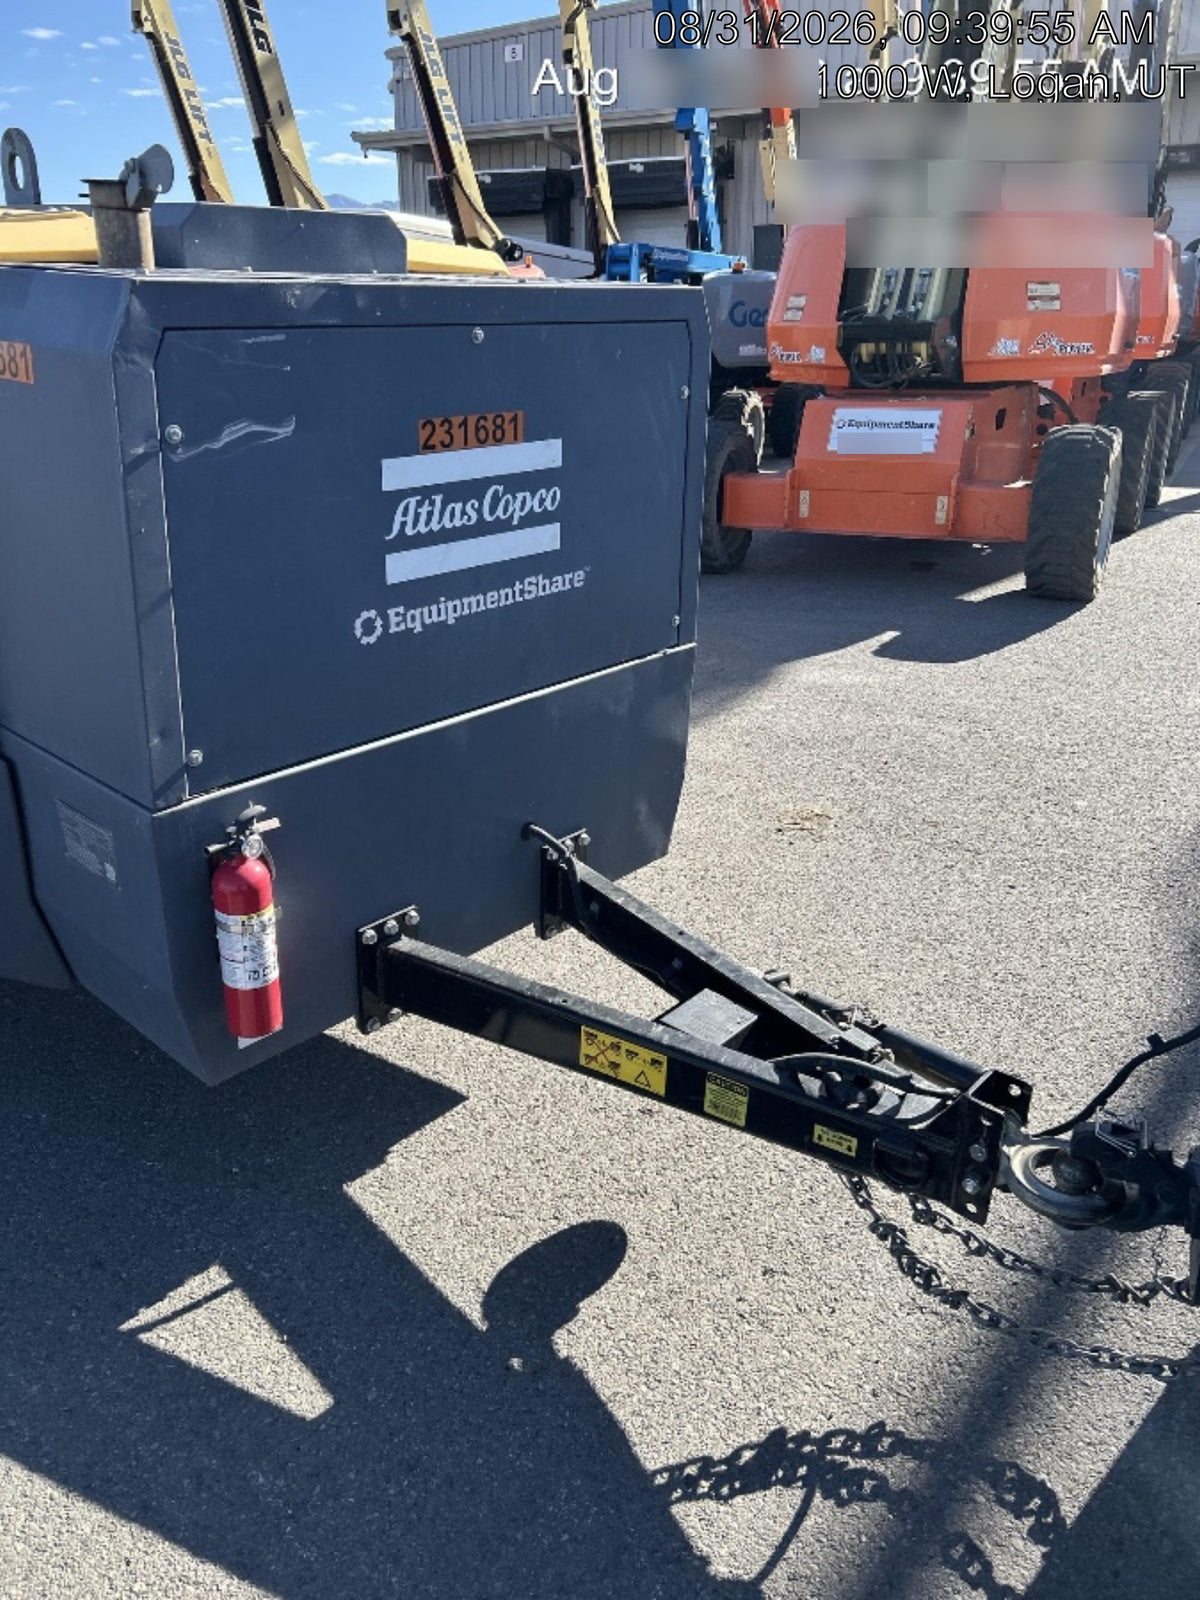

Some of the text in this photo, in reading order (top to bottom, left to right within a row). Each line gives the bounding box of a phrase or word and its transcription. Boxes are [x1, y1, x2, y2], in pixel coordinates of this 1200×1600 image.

[163, 31, 193, 80] JLG
[184, 88, 215, 145] LIFT
[728, 300, 768, 328] Ge
[420, 411, 521, 451] 231681
[384, 484, 561, 540] Atlas Copco
[387, 569, 586, 634] EquipmentShare
